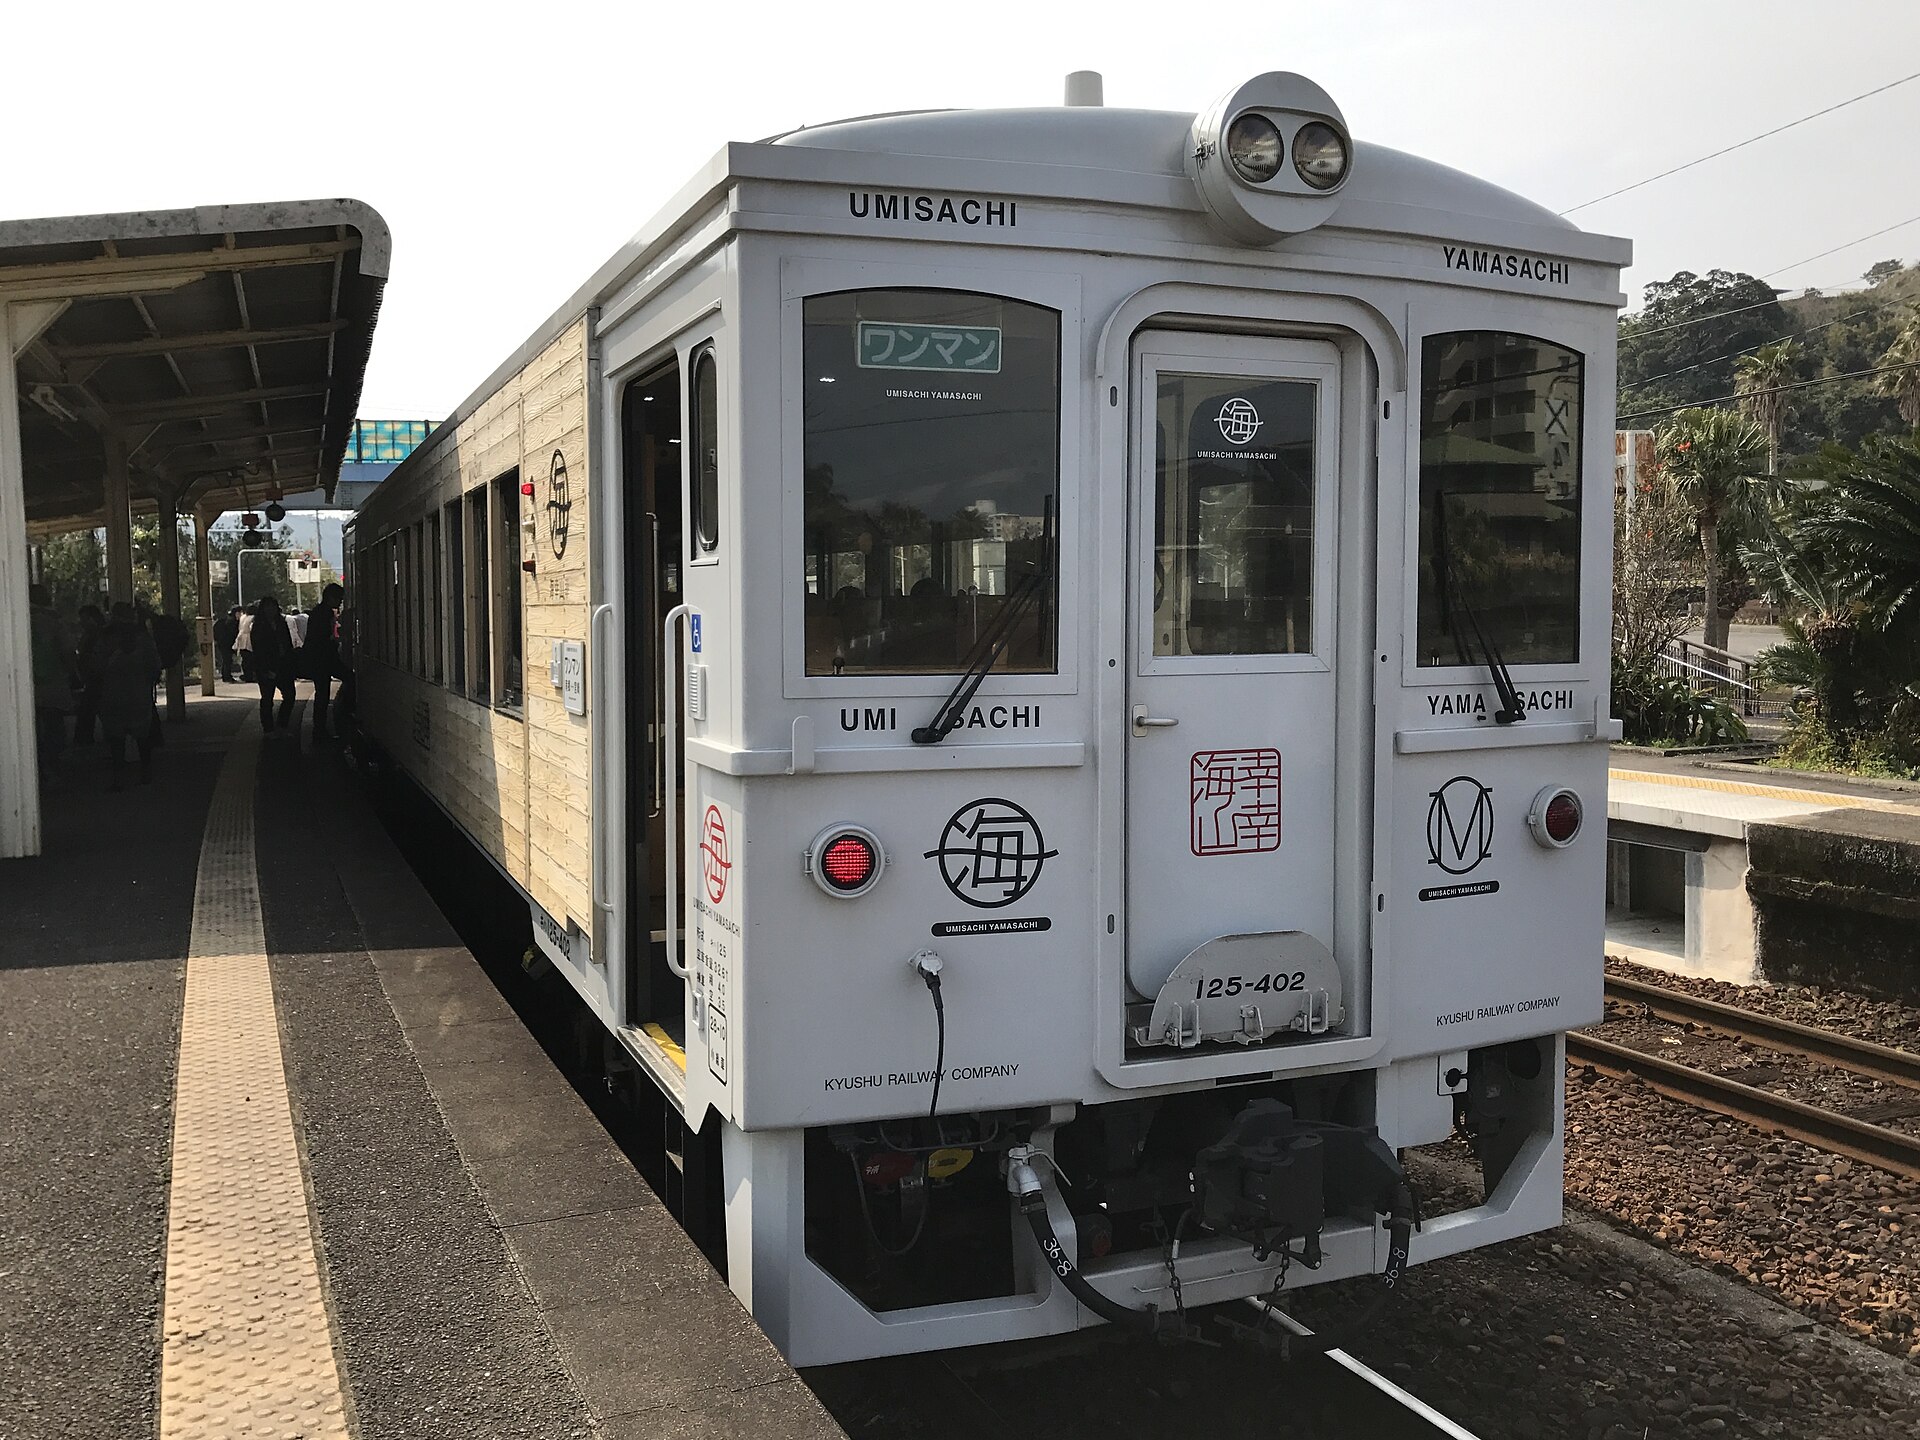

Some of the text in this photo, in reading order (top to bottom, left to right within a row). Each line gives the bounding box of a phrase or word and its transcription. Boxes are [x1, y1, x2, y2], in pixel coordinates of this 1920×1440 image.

[849, 192, 1016, 227] UMISACHI
[1442, 246, 1569, 285] YAMASACHI
[864, 328, 996, 367] ワンマン
[886, 389, 982, 401] UMISACHI YAMASACHI
[1197, 451, 1277, 460] UMISACHI YAMASACHI
[304, 553, 310, 562] 2
[1427, 693, 1487, 716] YAMA
[840, 707, 896, 732] UMI
[1428, 884, 1491, 898] UMISACHI YAMASACHI
[945, 921, 1038, 933] UMISACHI YAMASACHI
[1195, 971, 1305, 1000] 125-402
[1436, 996, 1561, 1027] KYUSHU RAILWAY COMPANY
[824, 1063, 1020, 1091] KYUSHU RAILWAY COMPANY
[1043, 1237, 1072, 1277] 36-8
[1382, 1246, 1406, 1289] 36-8
